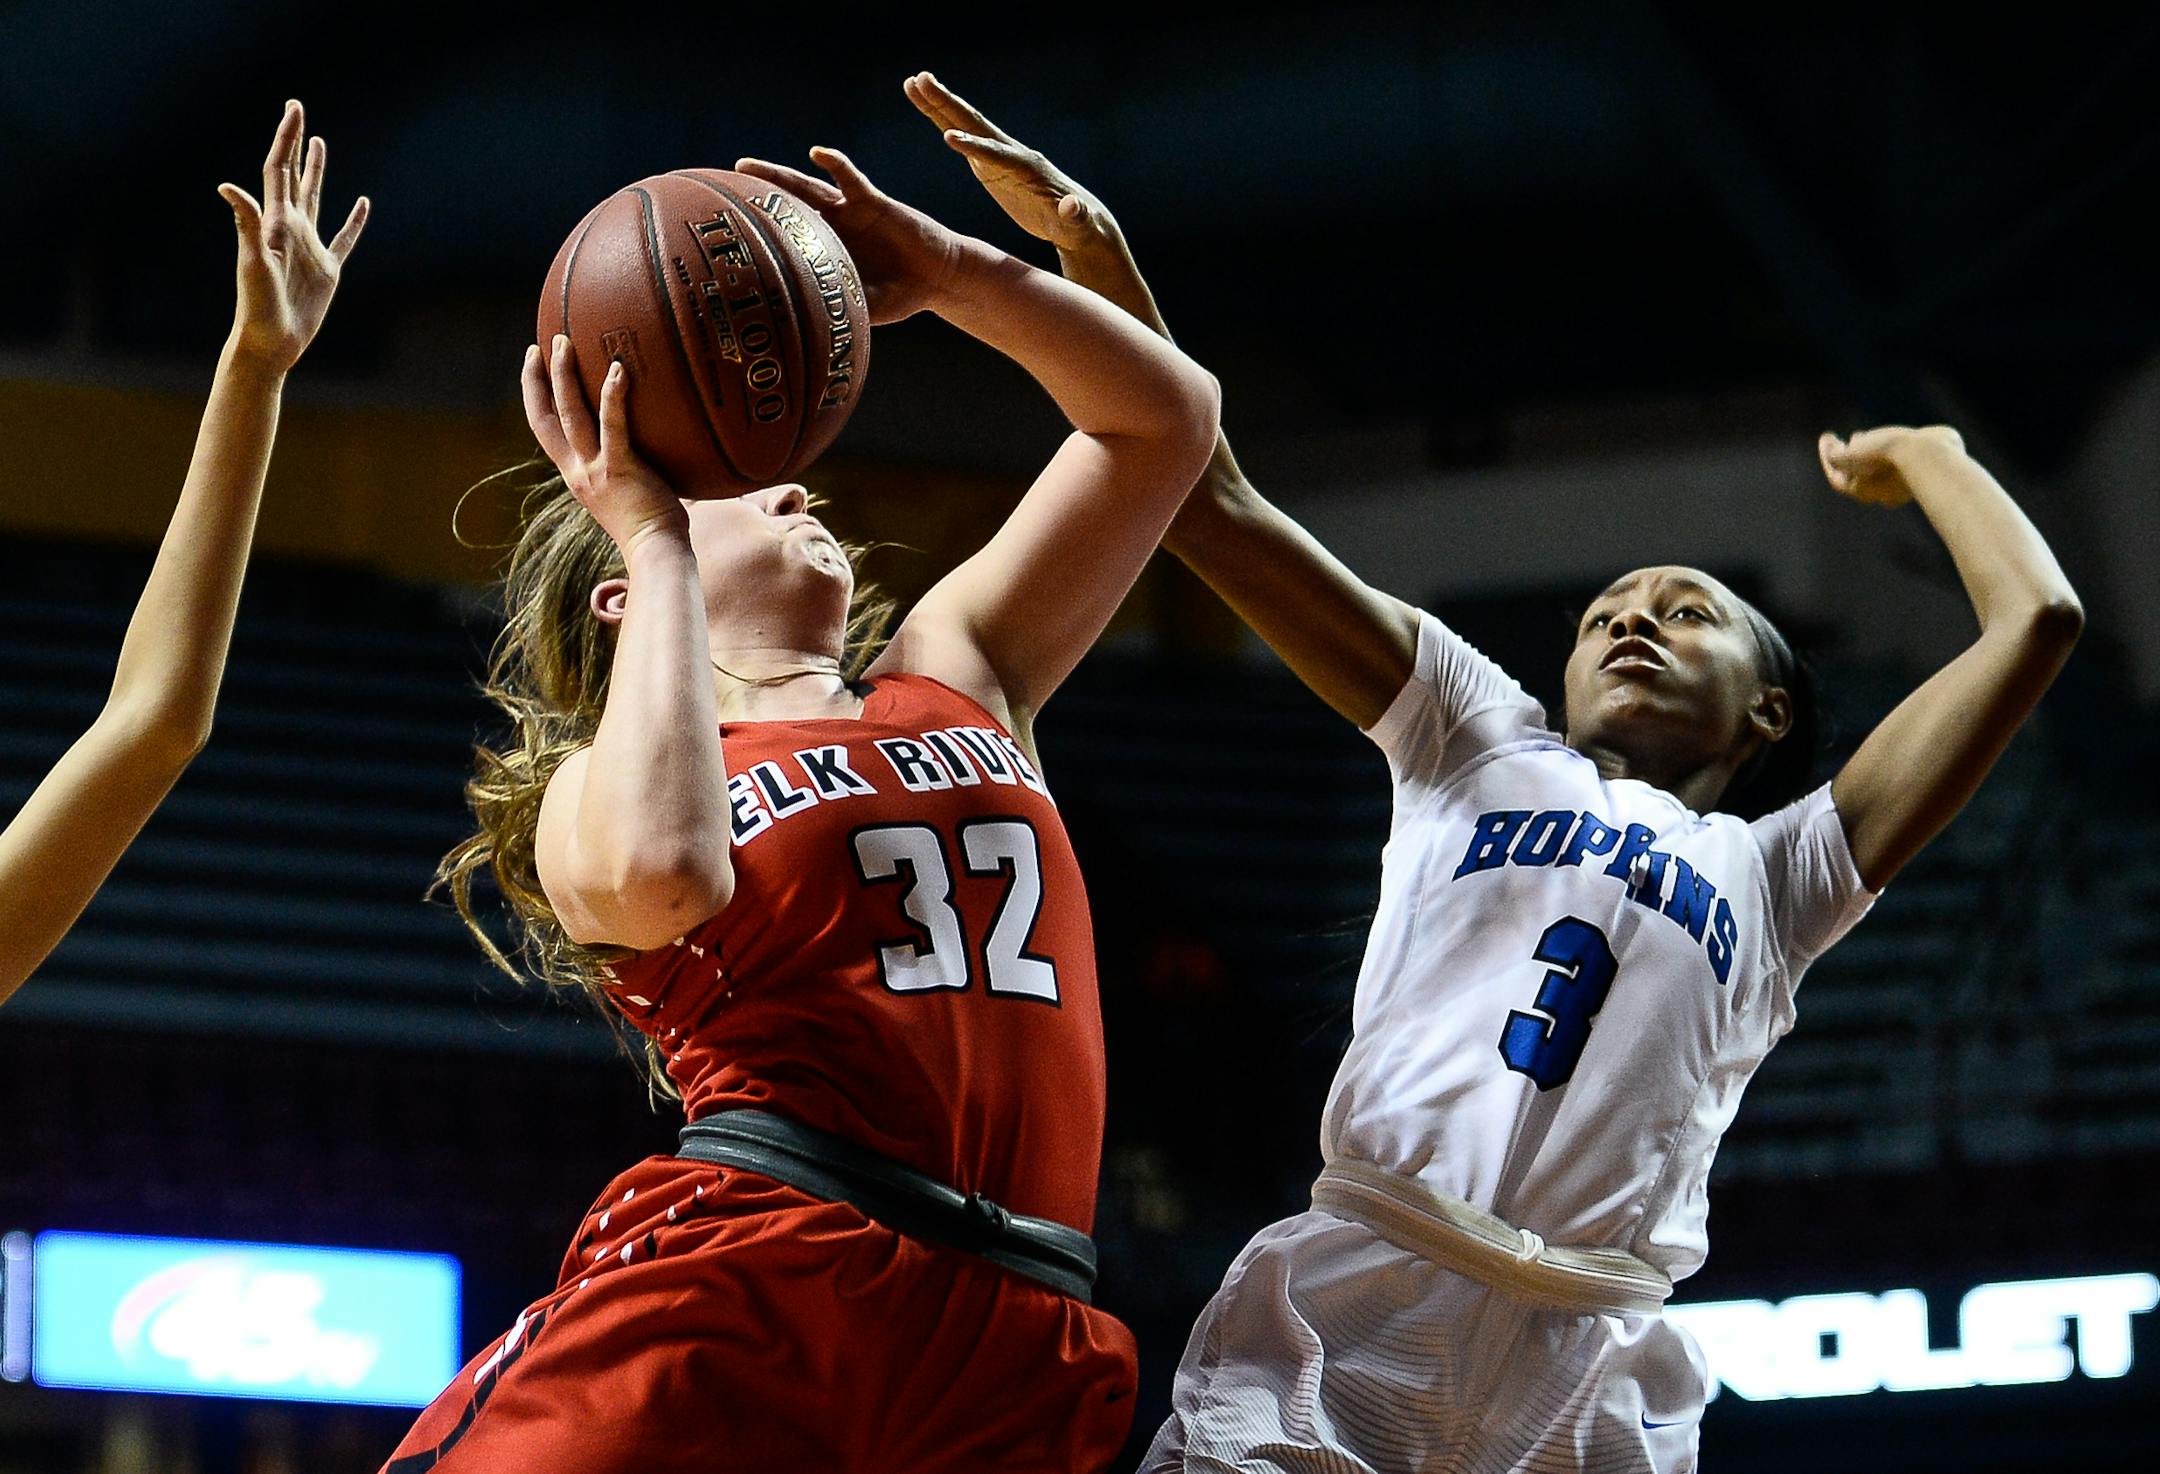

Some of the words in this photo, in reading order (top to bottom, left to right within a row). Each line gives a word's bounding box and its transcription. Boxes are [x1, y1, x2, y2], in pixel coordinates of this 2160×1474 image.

[696, 210, 786, 423] TF-1000
[700, 280, 743, 366] LEGACY
[749, 192, 853, 410] SPALDING
[728, 745, 878, 847] ELK
[873, 726, 1056, 804] RIVE
[852, 815, 1063, 1008] 32
[1451, 808, 1739, 986] HOPKINS
[1497, 914, 1620, 1093] 3
